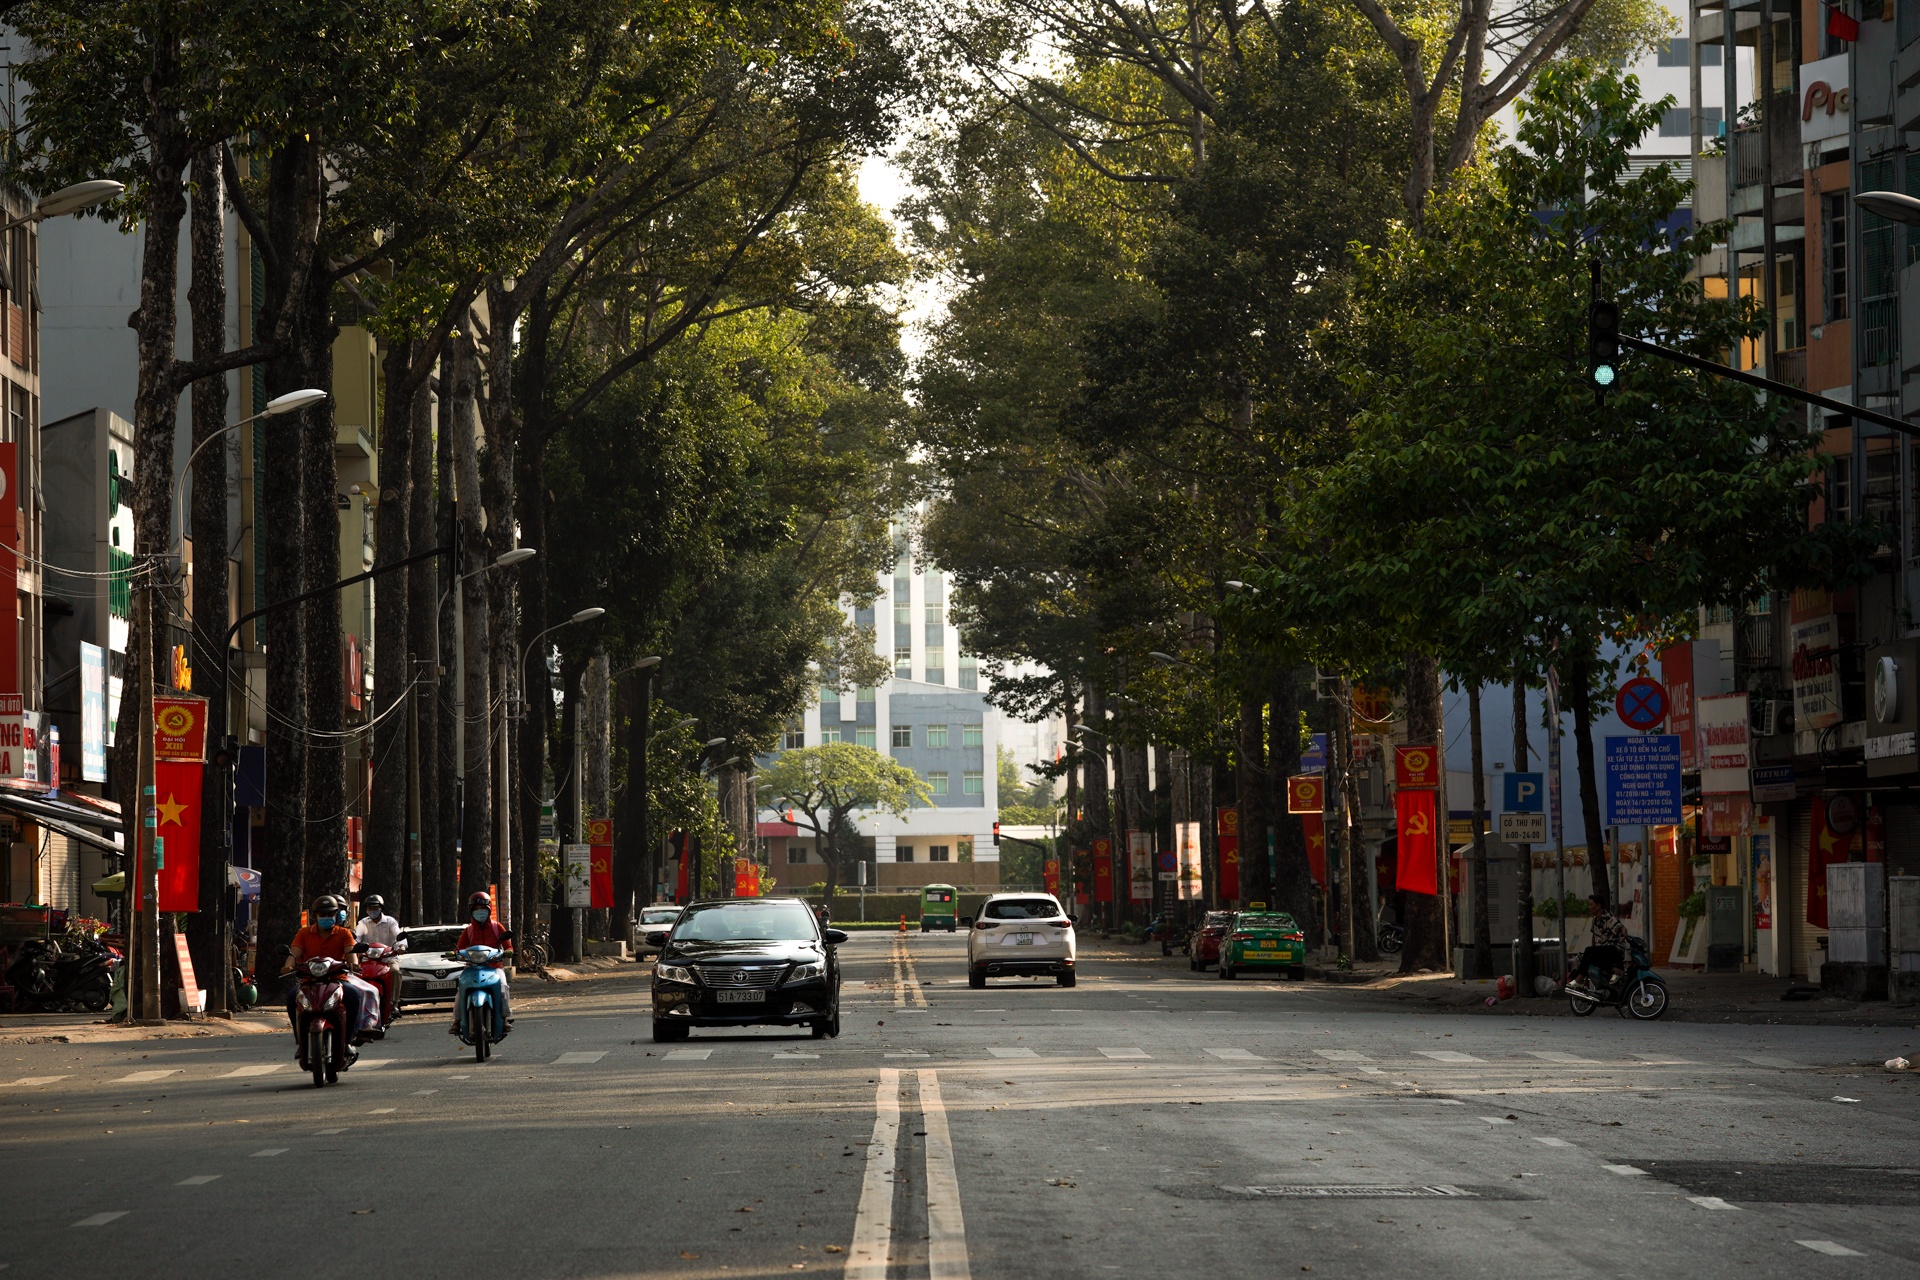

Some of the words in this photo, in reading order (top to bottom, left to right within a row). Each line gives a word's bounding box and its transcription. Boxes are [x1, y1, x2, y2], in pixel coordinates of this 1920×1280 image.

[8, 698, 20, 712] ÔTÔ
[1756, 769, 1789, 778] VIETMAP
[1518, 782, 1536, 802] P
[1504, 818, 1512, 826] CÓ
[1532, 817, 1542, 826] PHÍ
